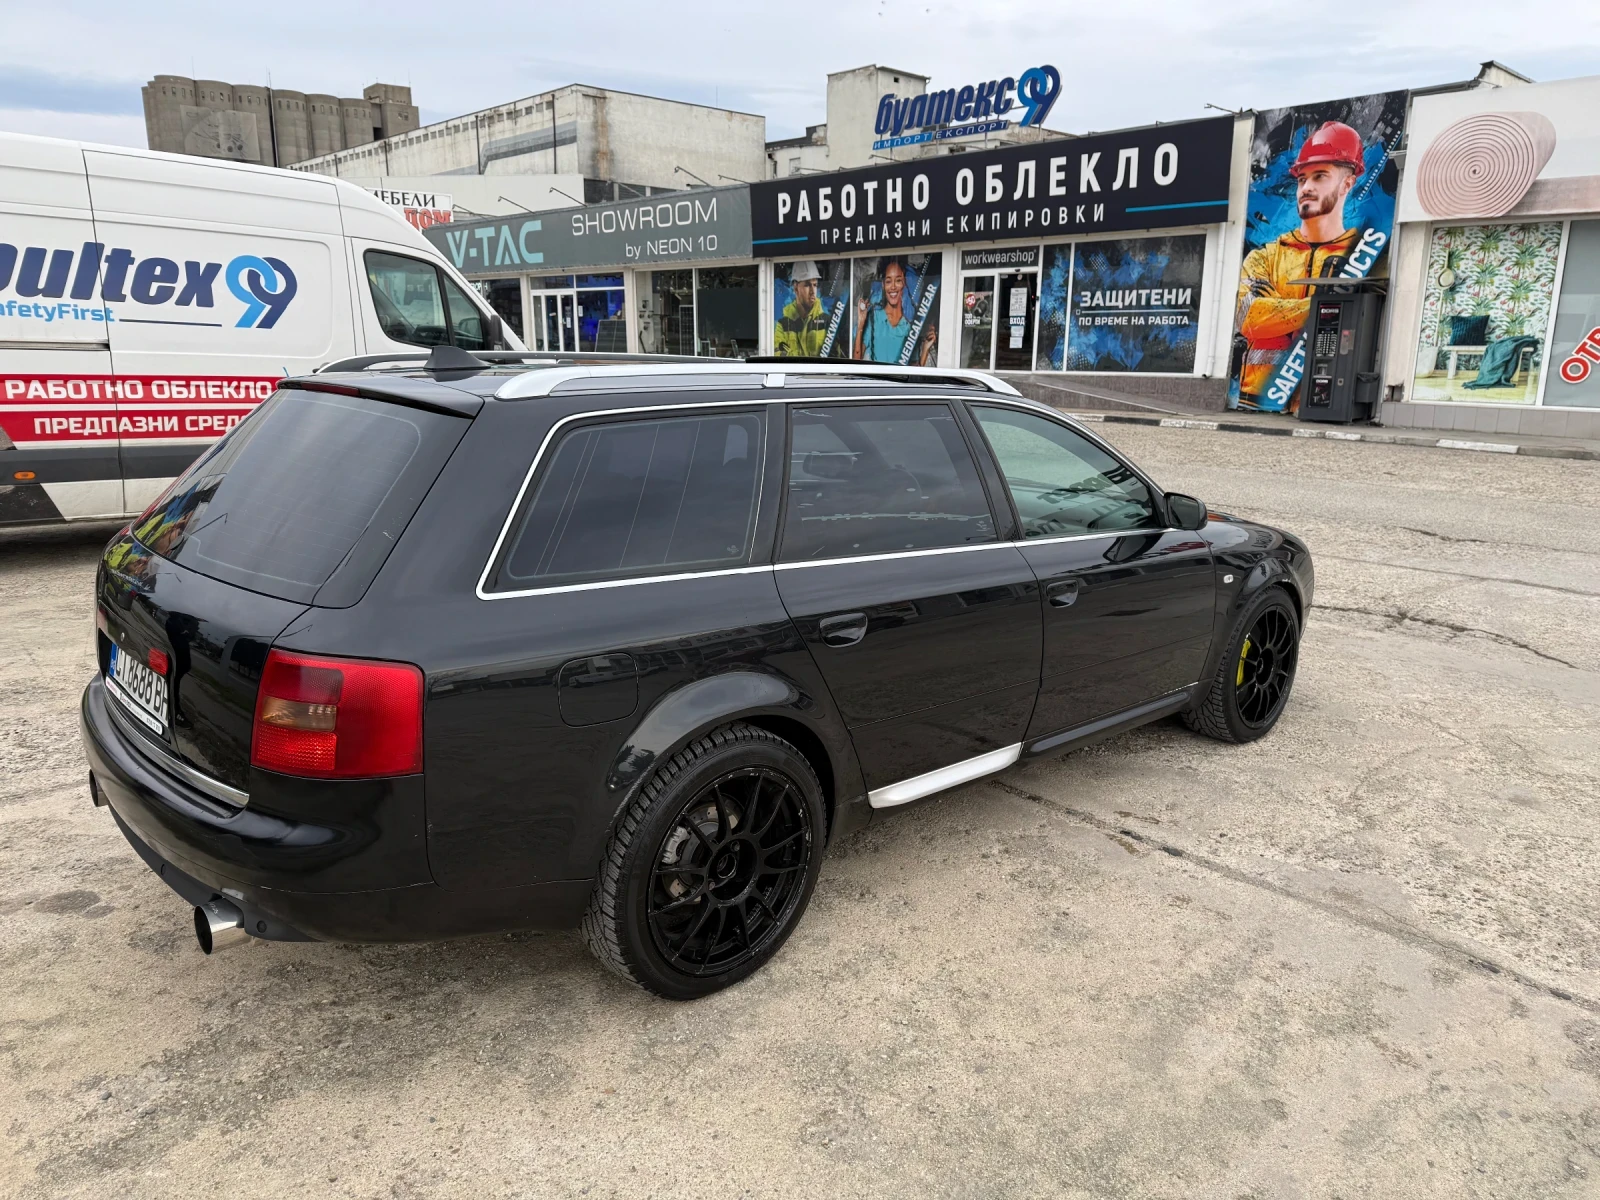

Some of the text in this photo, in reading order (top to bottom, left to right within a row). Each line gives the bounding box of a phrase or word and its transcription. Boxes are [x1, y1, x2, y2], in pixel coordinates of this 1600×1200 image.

[874, 64, 1062, 137] бултекс 99
[874, 120, 1008, 150] ИМПОРТ ЕКСПОРТ
[777, 142, 1179, 225] РАБОТНО ОБЛЕКЛО
[571, 197, 718, 237] SHOWROOM
[820, 203, 1105, 246] ПРЕДПАЗНИ ЕКИПИРОВКИ
[445, 219, 545, 269] V-TAC
[625, 234, 718, 260] by NEON 10
[1338, 227, 1387, 280] UCTS
[1080, 288, 1192, 309] ЗАЩИТЕНИ
[898, 317, 924, 366] MEDICAL
[917, 283, 938, 320] WEAR
[1009, 316, 1026, 326] ВХОД
[1078, 315, 1189, 326] ПО ВРЕМЕ НА РАБОТА
[4, 379, 273, 400] РАБОТНО ОБЛЕКЛО
[34, 415, 179, 436] ПРЕДПАЗНИ
